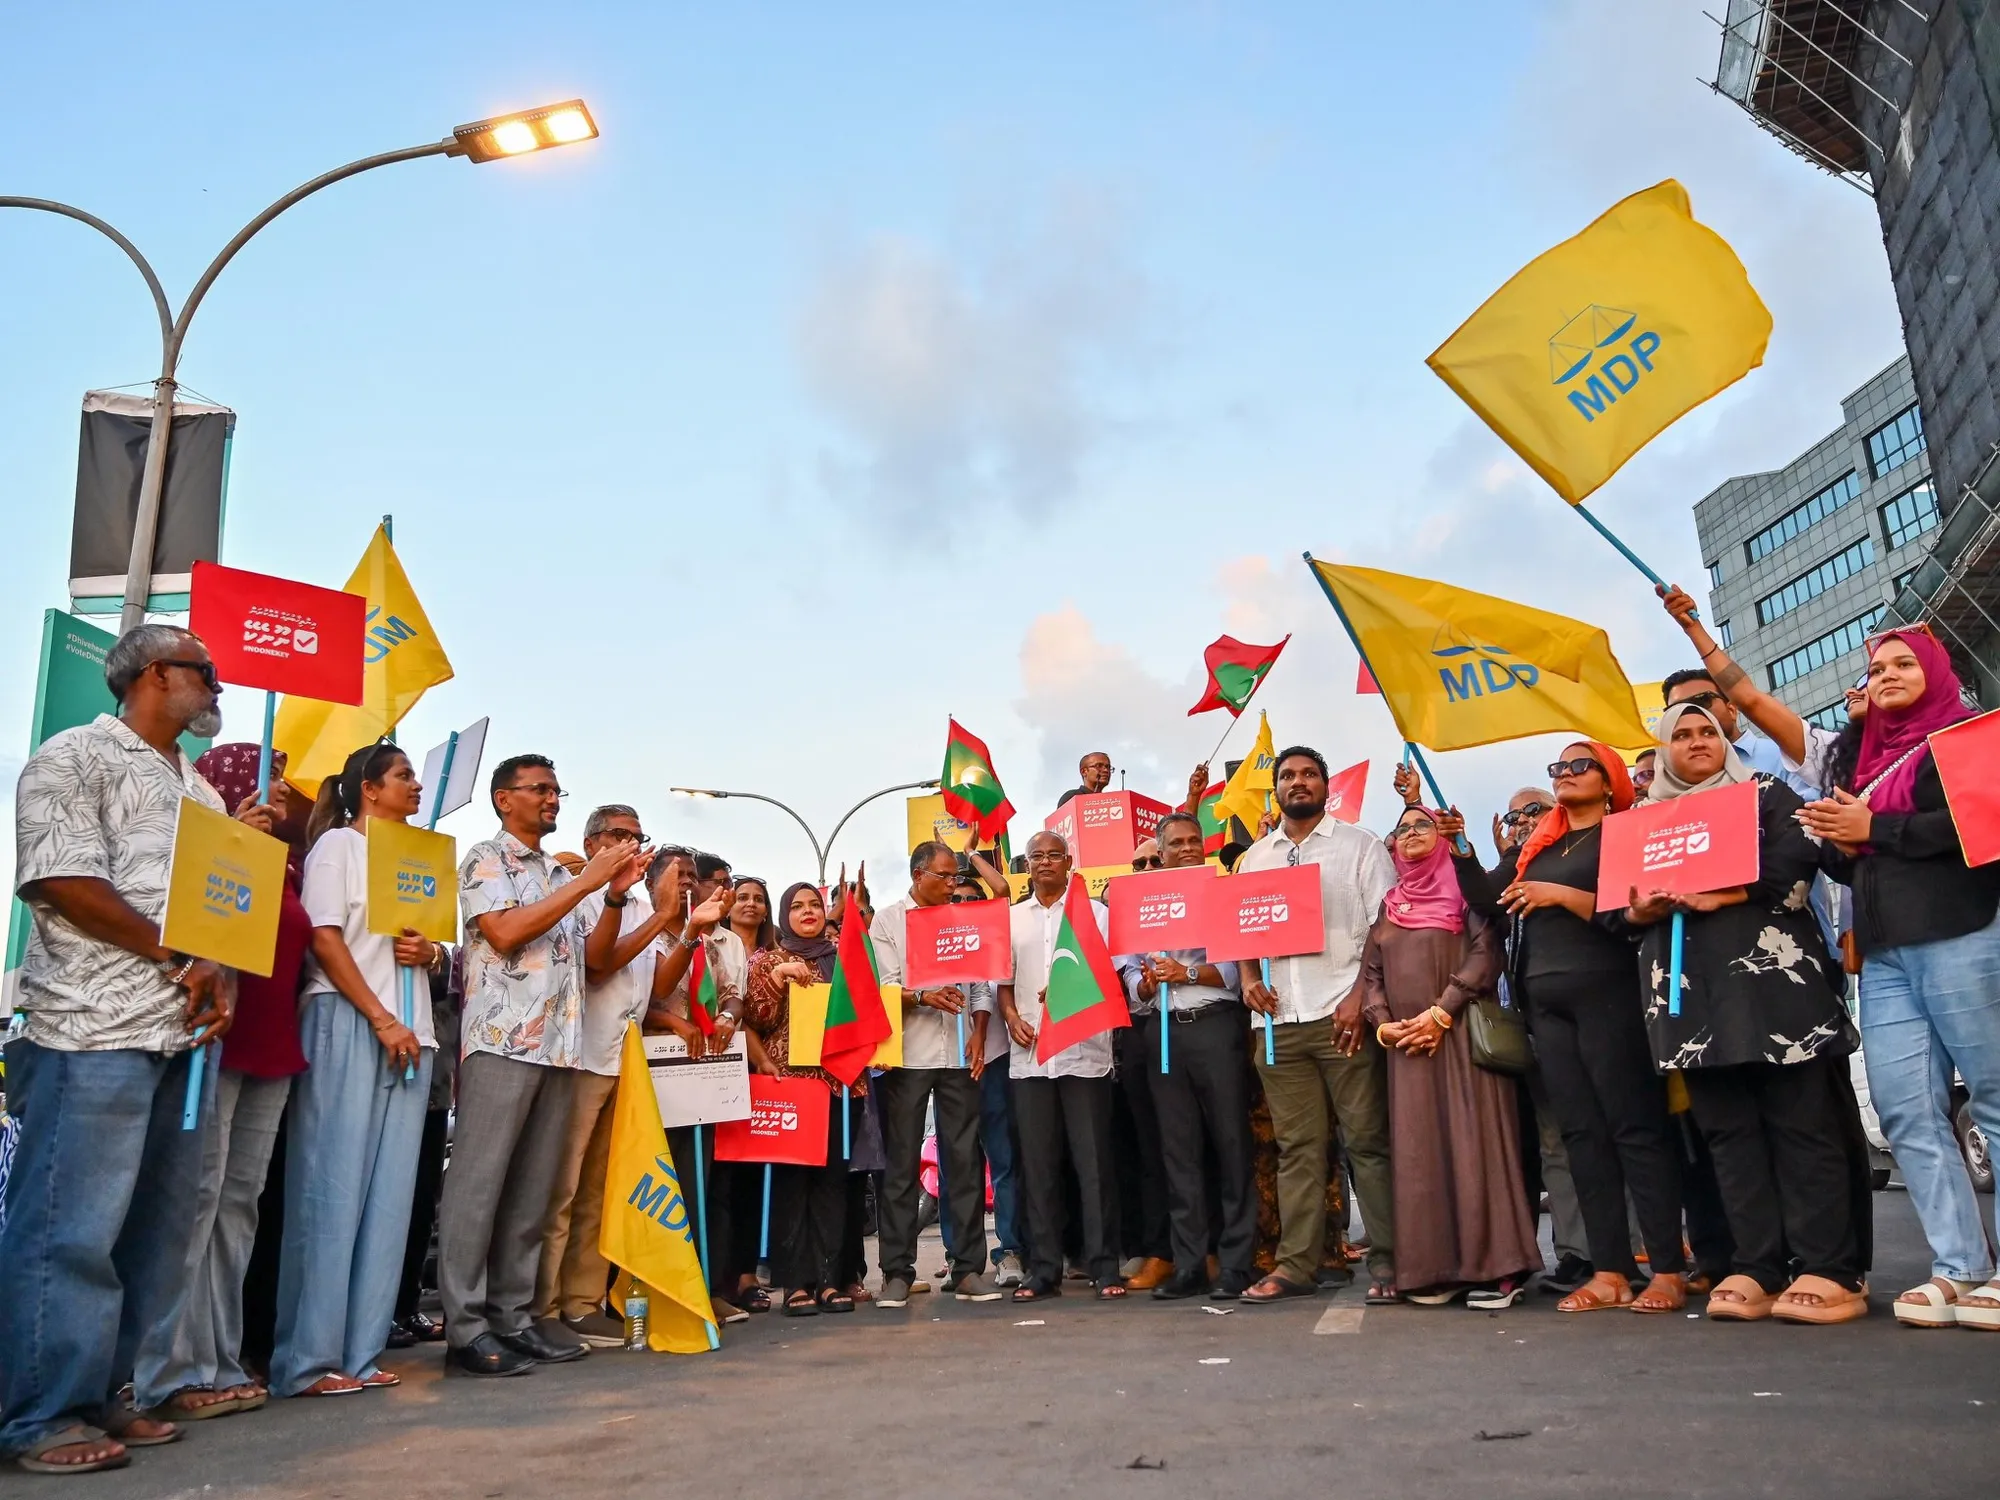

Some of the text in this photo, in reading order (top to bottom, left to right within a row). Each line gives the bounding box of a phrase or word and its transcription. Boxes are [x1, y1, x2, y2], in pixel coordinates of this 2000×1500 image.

[1567, 331, 1661, 422] MDP
[65, 643, 106, 667] #VoteDhoo
[243, 644, 290, 658] #NOONEKEY
[1438, 659, 1539, 703] MDP
[628, 1172, 694, 1243] MD
